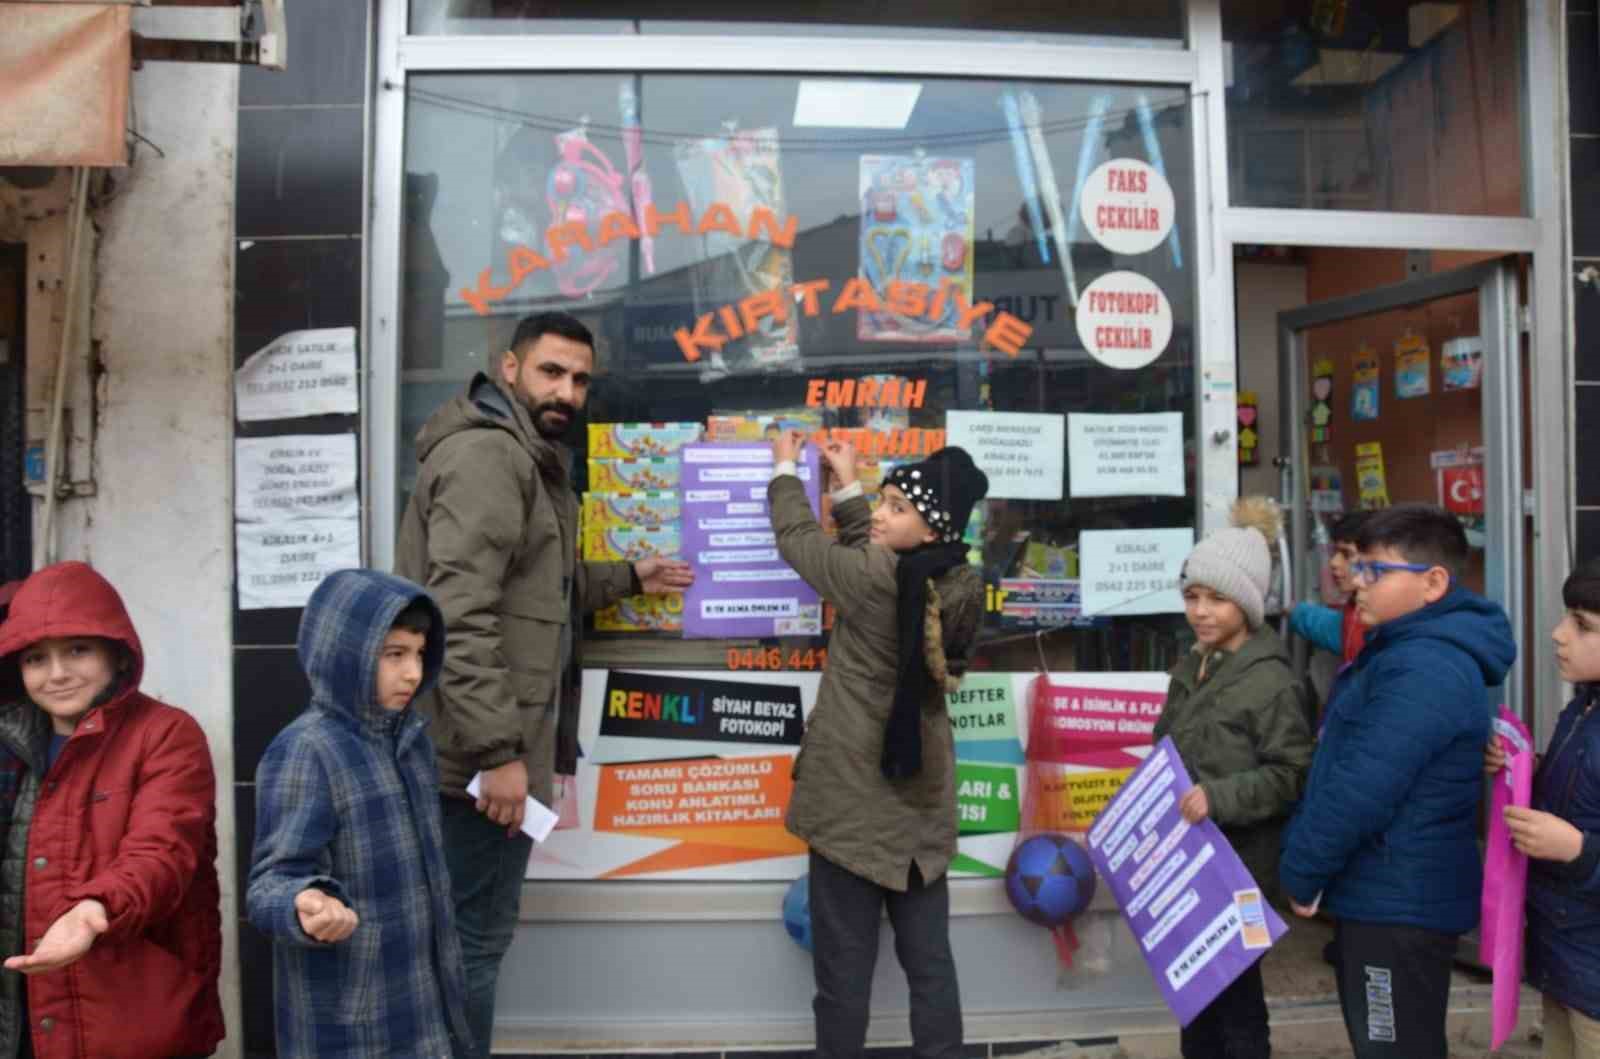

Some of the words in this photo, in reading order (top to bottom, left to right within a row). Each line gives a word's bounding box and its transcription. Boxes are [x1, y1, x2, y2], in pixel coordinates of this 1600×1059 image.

[1107, 169, 1148, 193] FAKS
[1096, 202, 1160, 235] ÇEKİLİR
[458, 200, 797, 316] KARAHAN
[673, 276, 1034, 362] KIRTASİYE
[1095, 321, 1153, 353] ÇEKİLİR
[806, 378, 928, 408] EMRAH
[727, 648, 782, 671] 0446
[711, 695, 752, 714] SİYAH
[754, 700, 797, 720] BEYAZ
[950, 687, 1006, 705] DEFTER
[614, 767, 683, 782] TAMAMI
[630, 783, 678, 797] SORU
[682, 778, 760, 794] BANKASI
[997, 782, 1012, 800] &
[625, 799, 674, 812] KONU
[678, 792, 766, 809] ANLATIMLI
[612, 812, 690, 828] HAZIRLIK
[694, 806, 782, 823] KİTAPLARI
